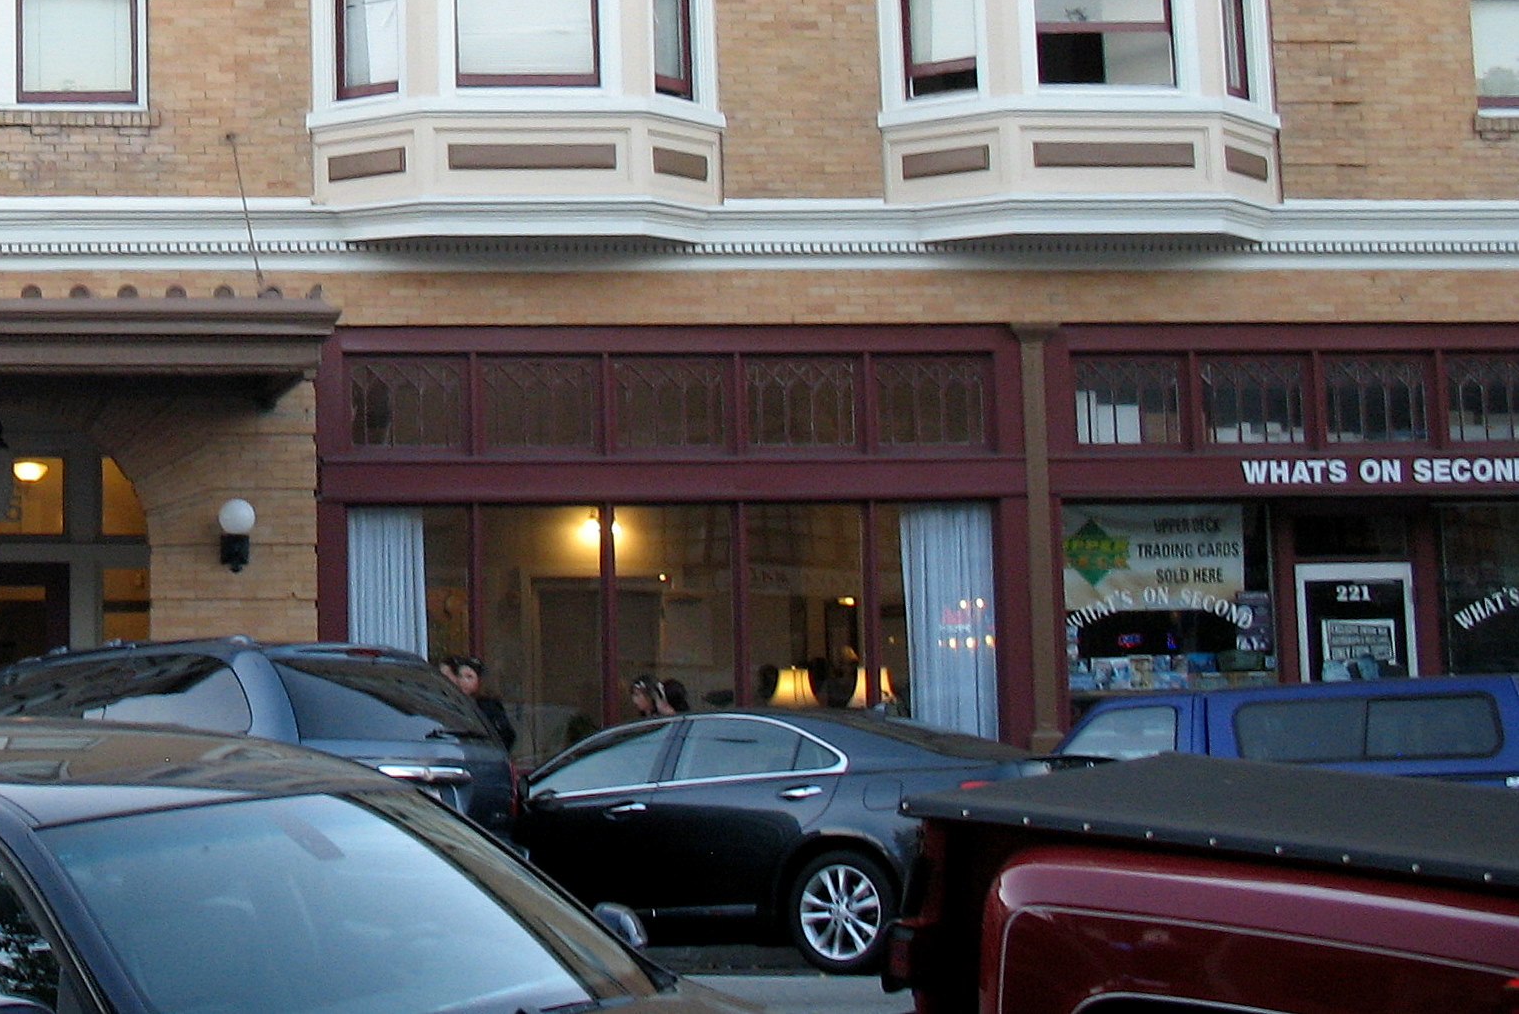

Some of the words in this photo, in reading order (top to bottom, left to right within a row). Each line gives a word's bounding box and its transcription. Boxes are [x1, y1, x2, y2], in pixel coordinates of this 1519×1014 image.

[1359, 459, 1402, 483] ON
[1154, 517, 1190, 533] UPPER
[1192, 517, 1221, 533] DECK
[1138, 543, 1193, 559] TRADING
[1197, 542, 1240, 558] CARDS
[1156, 567, 1189, 584] SOLD
[1193, 567, 1224, 584] HERE
[1336, 585, 1371, 602] 221
[1066, 588, 1134, 628] WHAT'S
[1143, 586, 1170, 605] ON
[1181, 588, 1254, 629] SECOND
[1454, 586, 1519, 630] WHAT'S
